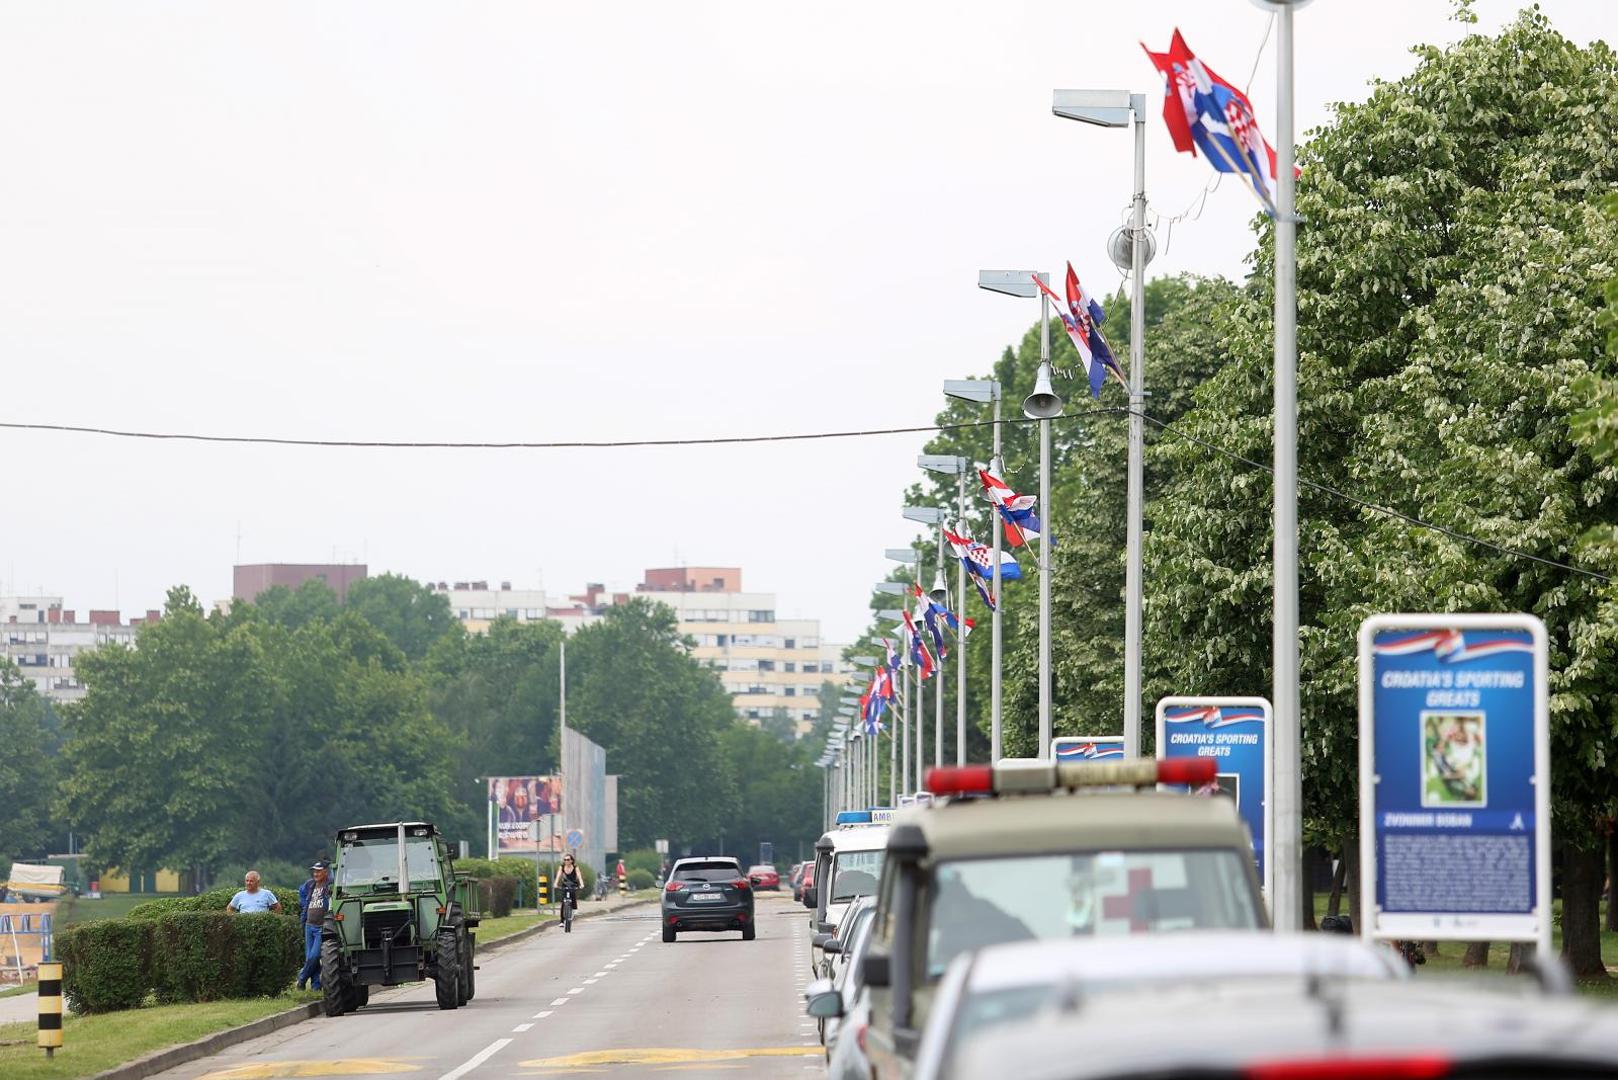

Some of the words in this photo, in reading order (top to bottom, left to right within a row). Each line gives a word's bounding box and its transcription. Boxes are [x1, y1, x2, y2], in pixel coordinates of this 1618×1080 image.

[1382, 671, 1453, 688] CROATIA'S
[1455, 671, 1524, 688] SPORTING
[1426, 689, 1480, 707] GREATS
[1171, 734, 1213, 744] CROATIA'S
[1216, 734, 1258, 744] SPORTING
[1198, 746, 1231, 756] GREATS
